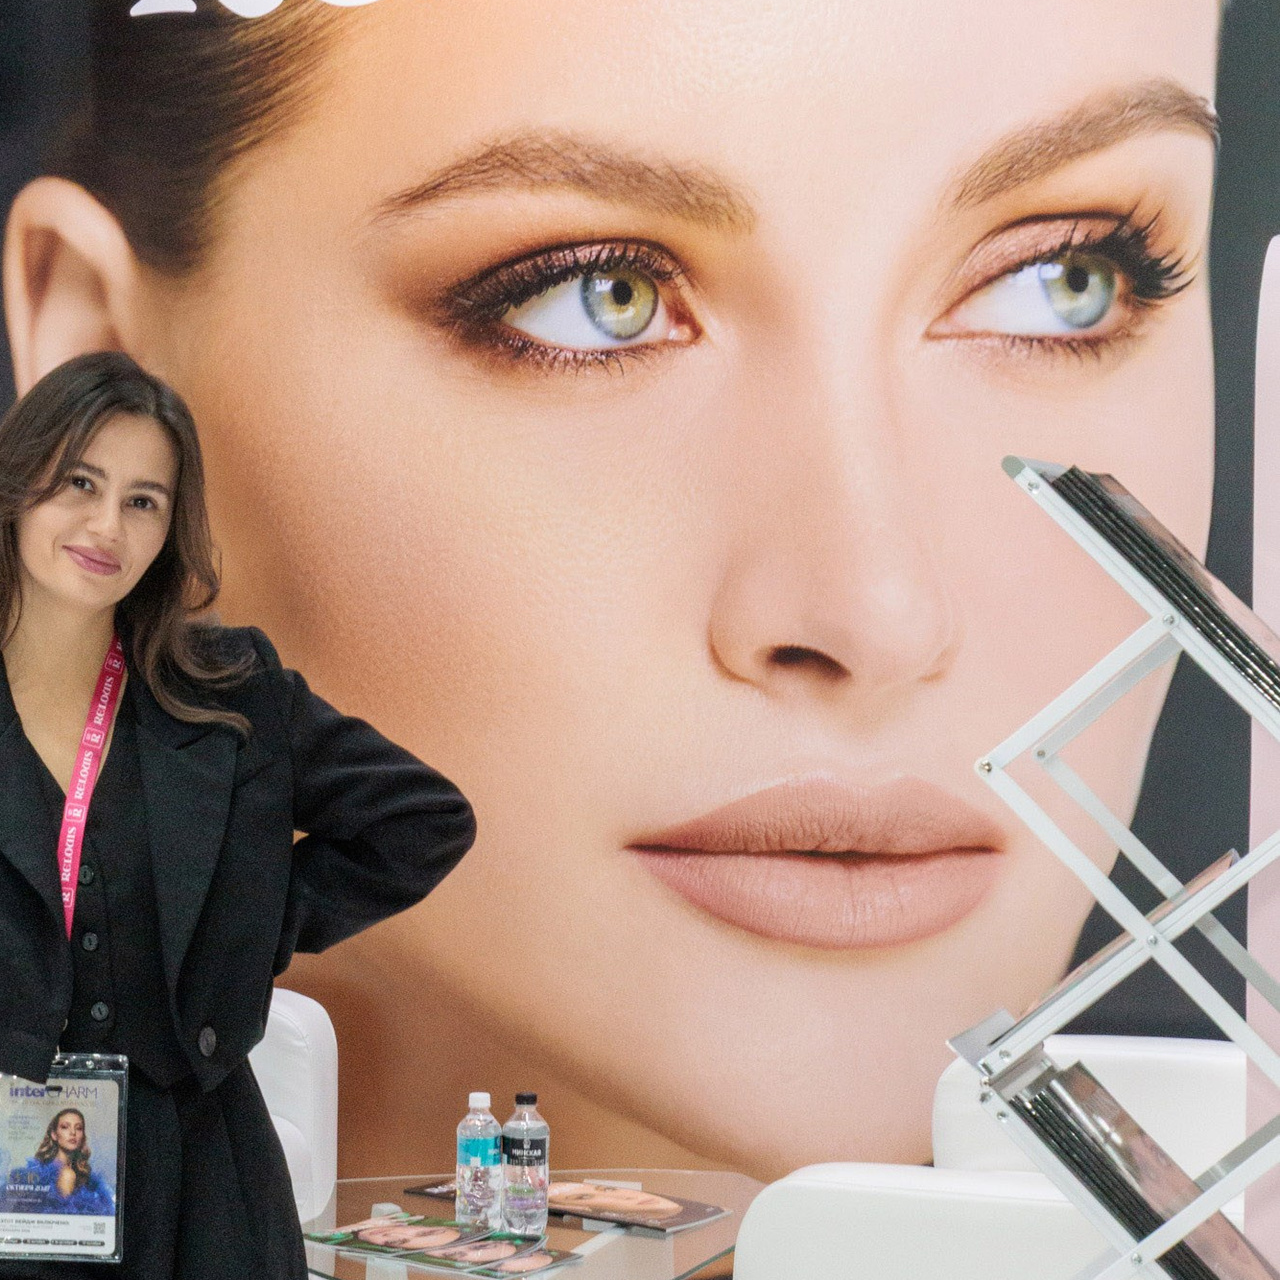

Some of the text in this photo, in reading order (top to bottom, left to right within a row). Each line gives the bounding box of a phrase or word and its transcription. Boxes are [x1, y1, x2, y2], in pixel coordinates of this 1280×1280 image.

[94, 676, 114, 725] RELOUIS
[74, 750, 93, 800] RELOUIS
[61, 826, 77, 882] RELOUIS
